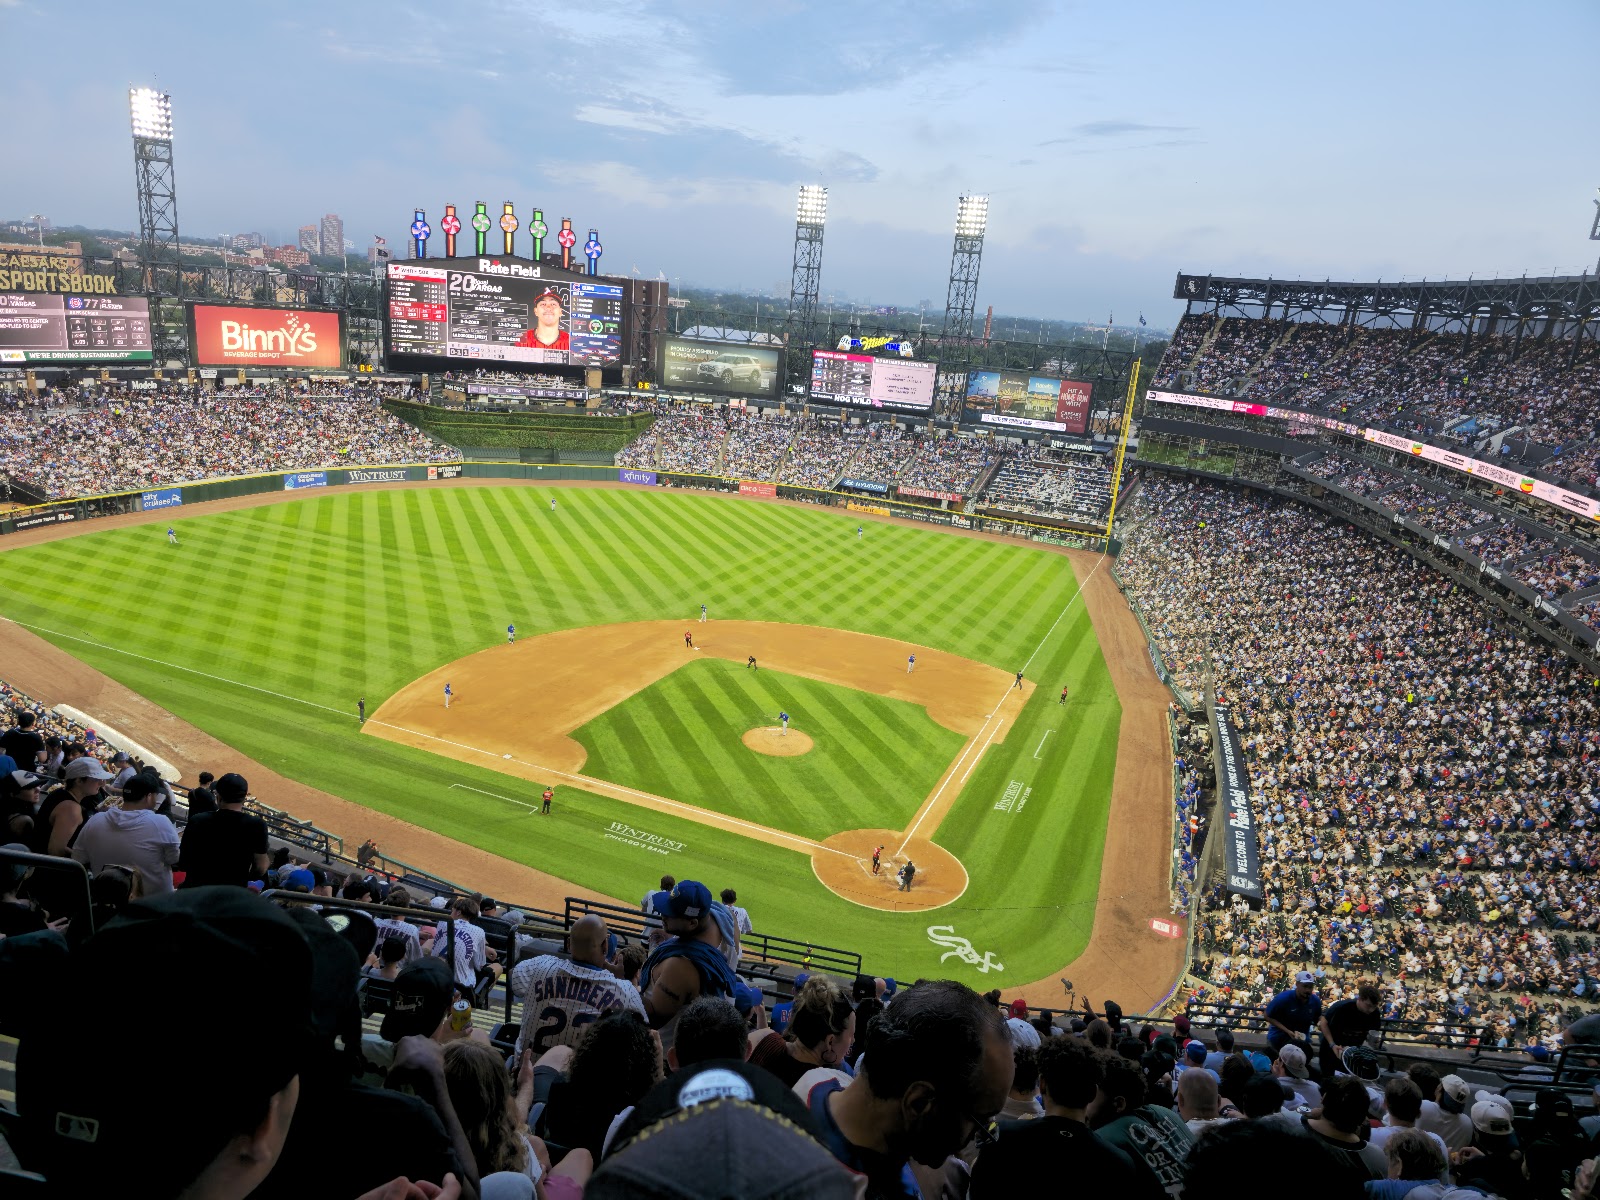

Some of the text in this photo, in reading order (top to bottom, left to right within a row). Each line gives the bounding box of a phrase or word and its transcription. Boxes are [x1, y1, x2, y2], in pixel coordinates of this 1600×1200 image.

[0, 254, 69, 270] CAESARS
[479, 258, 541, 278] Rate Field
[0, 270, 117, 294] SPORTSBOOK
[450, 274, 475, 292] 20
[473, 284, 502, 292] VARGAS
[84, 299, 98, 308] 77
[221, 320, 317, 356] Binny's
[860, 336, 893, 350] Miller
[834, 395, 850, 403] HOG
[853, 397, 871, 405] WILD
[1065, 443, 1092, 451] LANDING
[349, 470, 406, 481] WINTRUST
[624, 472, 650, 483] xfinity
[144, 499, 170, 507] cruises
[952, 515, 970, 525] Rate
[1216, 712, 1225, 722] SOX
[1218, 721, 1228, 735] WHITE
[1221, 735, 1233, 755] CHICAGO
[1226, 756, 1235, 766] THE
[1228, 772, 1239, 787] HOME
[994, 779, 1020, 810] WINTRUST
[1229, 788, 1247, 809] Field
[1229, 808, 1250, 829] Rate
[610, 822, 687, 850] WINTRUST
[1235, 830, 1245, 839] TO
[604, 834, 669, 855] CHICAGO'S BANK
[1236, 840, 1248, 873] WELCOME
[432, 928, 474, 961] ROW-MSTRONG
